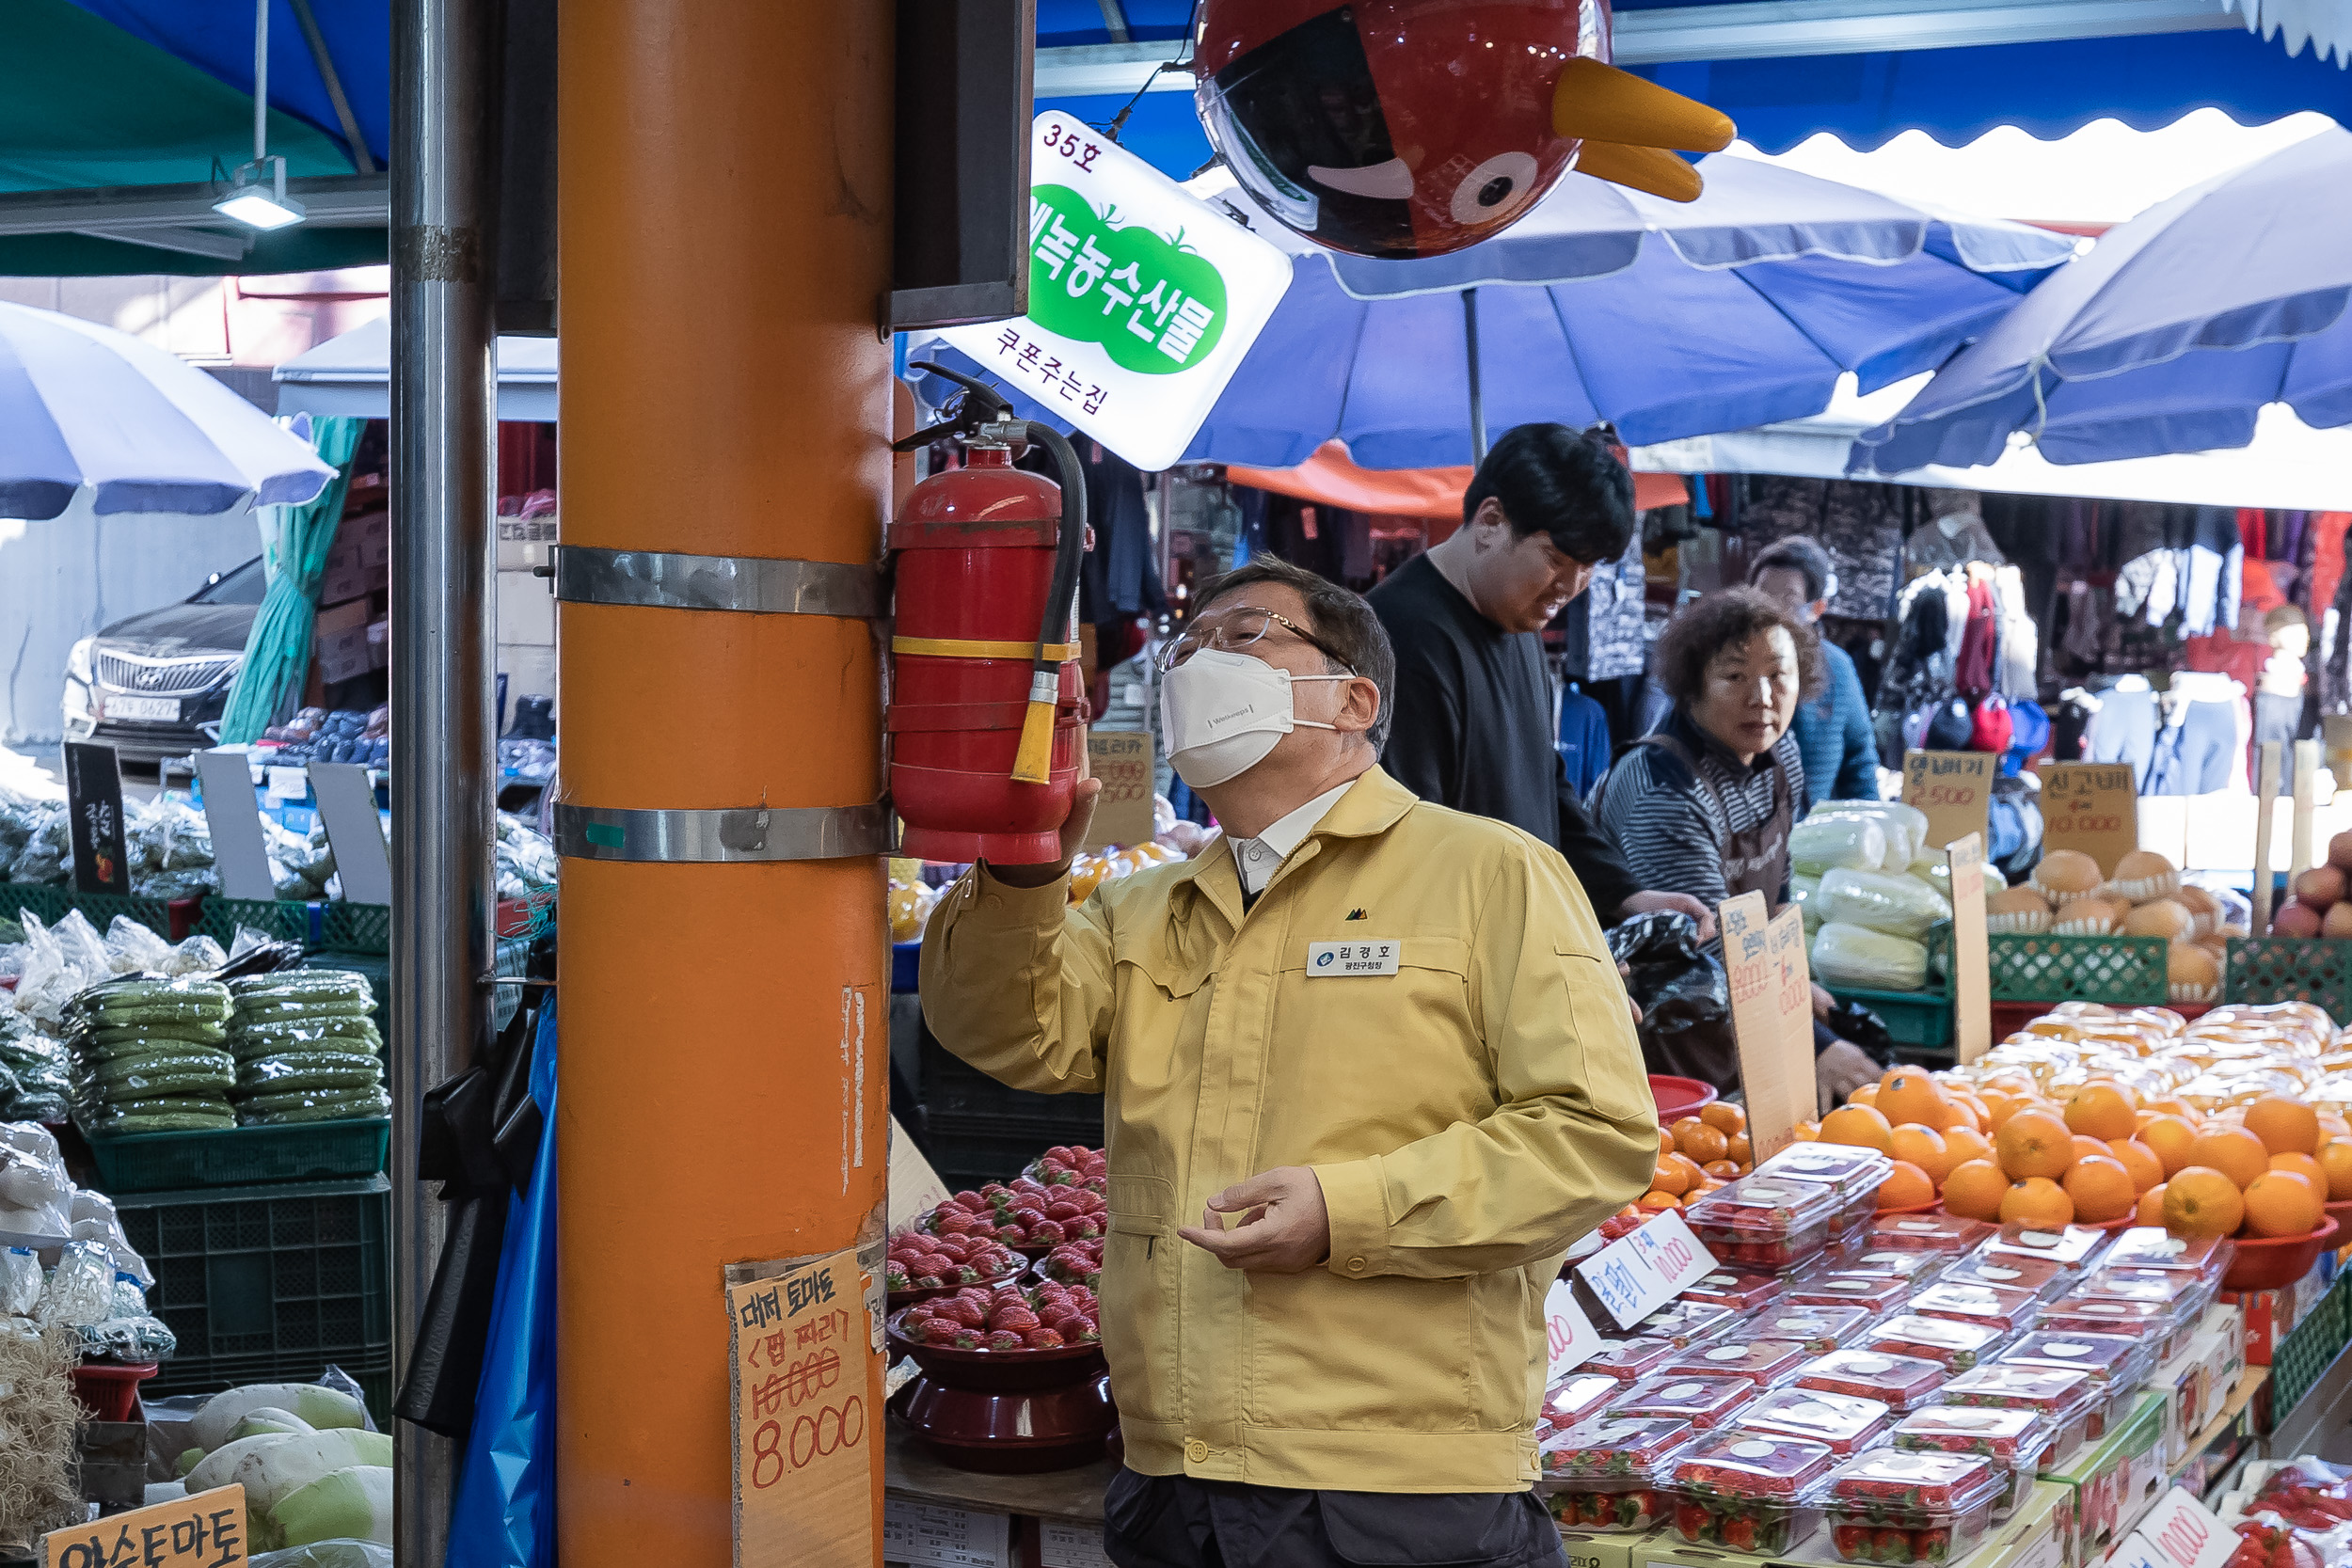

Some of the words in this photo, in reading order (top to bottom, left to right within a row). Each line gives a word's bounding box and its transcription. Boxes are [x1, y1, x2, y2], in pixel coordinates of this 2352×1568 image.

[1043, 123, 1102, 173] 35호
[1344, 961, 1382, 971] 광진구청장
[739, 1286, 783, 1328] 대저
[787, 1267, 836, 1318] 토마토
[753, 1395, 864, 1489] 8.000
